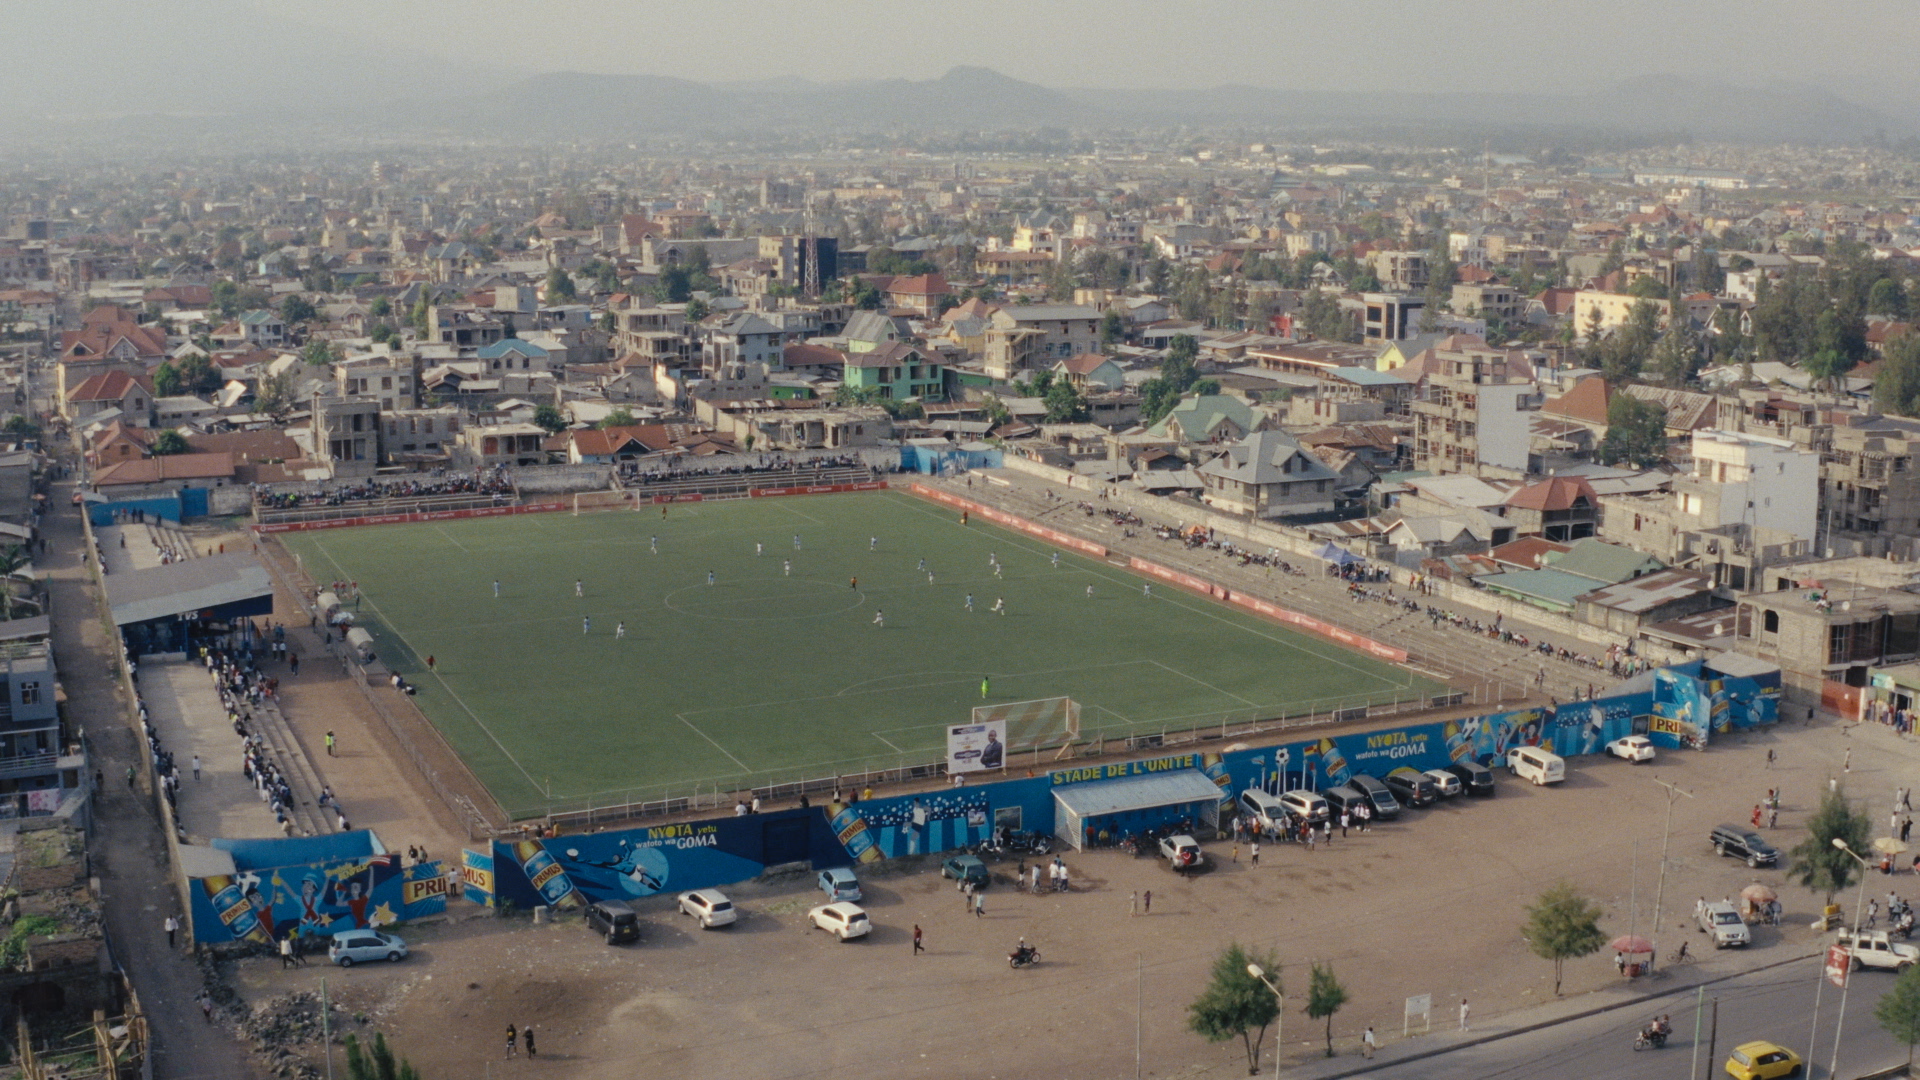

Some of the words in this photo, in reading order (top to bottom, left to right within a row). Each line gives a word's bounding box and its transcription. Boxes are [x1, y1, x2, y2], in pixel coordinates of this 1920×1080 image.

[177, 611, 198, 621] TVS
[1367, 732, 1407, 749] NYOTA
[1390, 742, 1426, 759] GOMA
[1053, 767, 1100, 785] STADE
[1107, 765, 1127, 777] DE
[1133, 755, 1193, 774] L'UNITE
[648, 824, 693, 839] NYOTA
[698, 825, 717, 836] yetu
[839, 818, 866, 844] PRIMUS
[676, 834, 717, 849] GOMA
[533, 863, 561, 887] PRIMUS
[221, 900, 249, 924] PRIMUS
